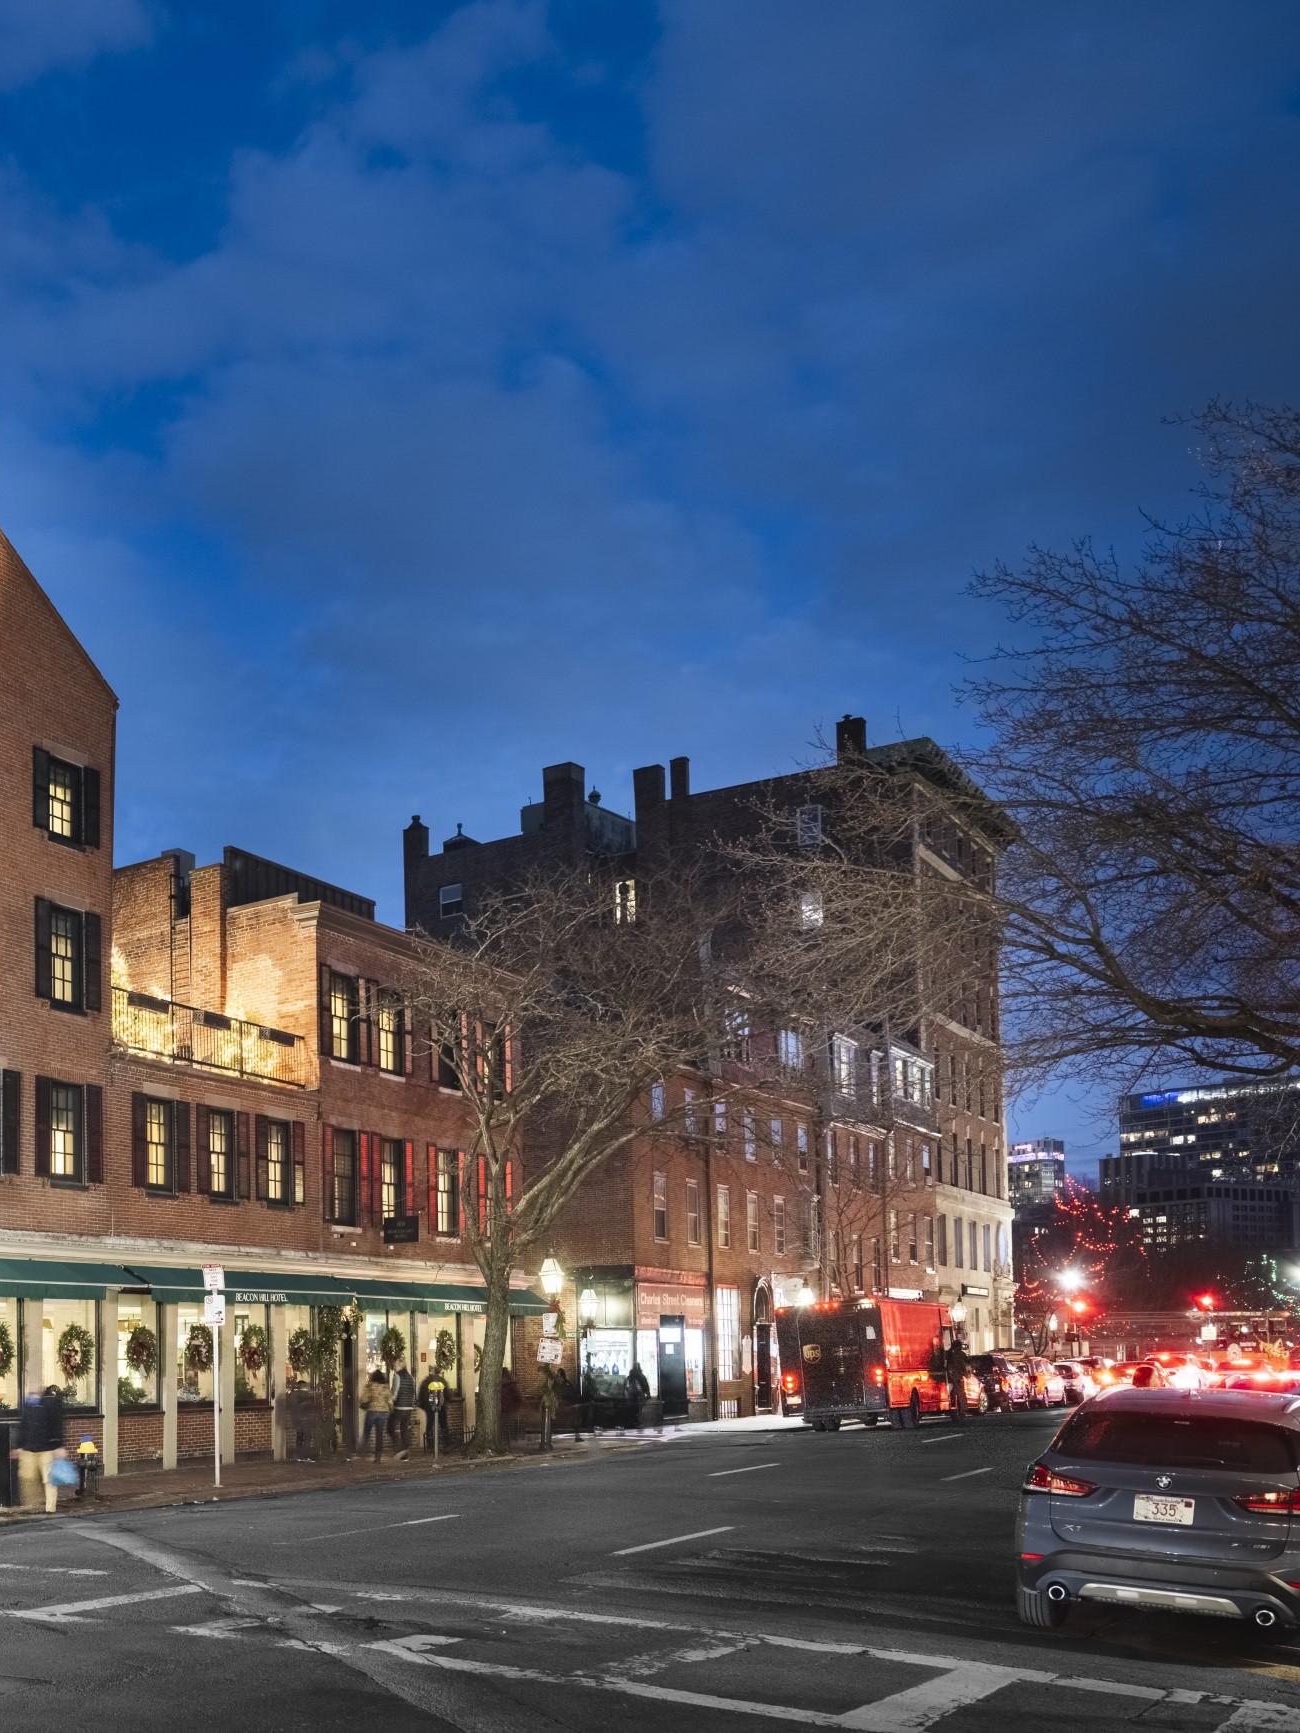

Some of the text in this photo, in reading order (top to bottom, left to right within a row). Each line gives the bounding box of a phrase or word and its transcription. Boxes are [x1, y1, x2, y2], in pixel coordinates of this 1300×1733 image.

[235, 1292, 288, 1302] BEACON HILL HOTEL
[640, 1292, 703, 1307] Charles Street Cleaners
[444, 1302, 482, 1312] BEACON HILL HOTEL
[805, 1350, 820, 1361] ups
[1151, 1502, 1177, 1517] 335
